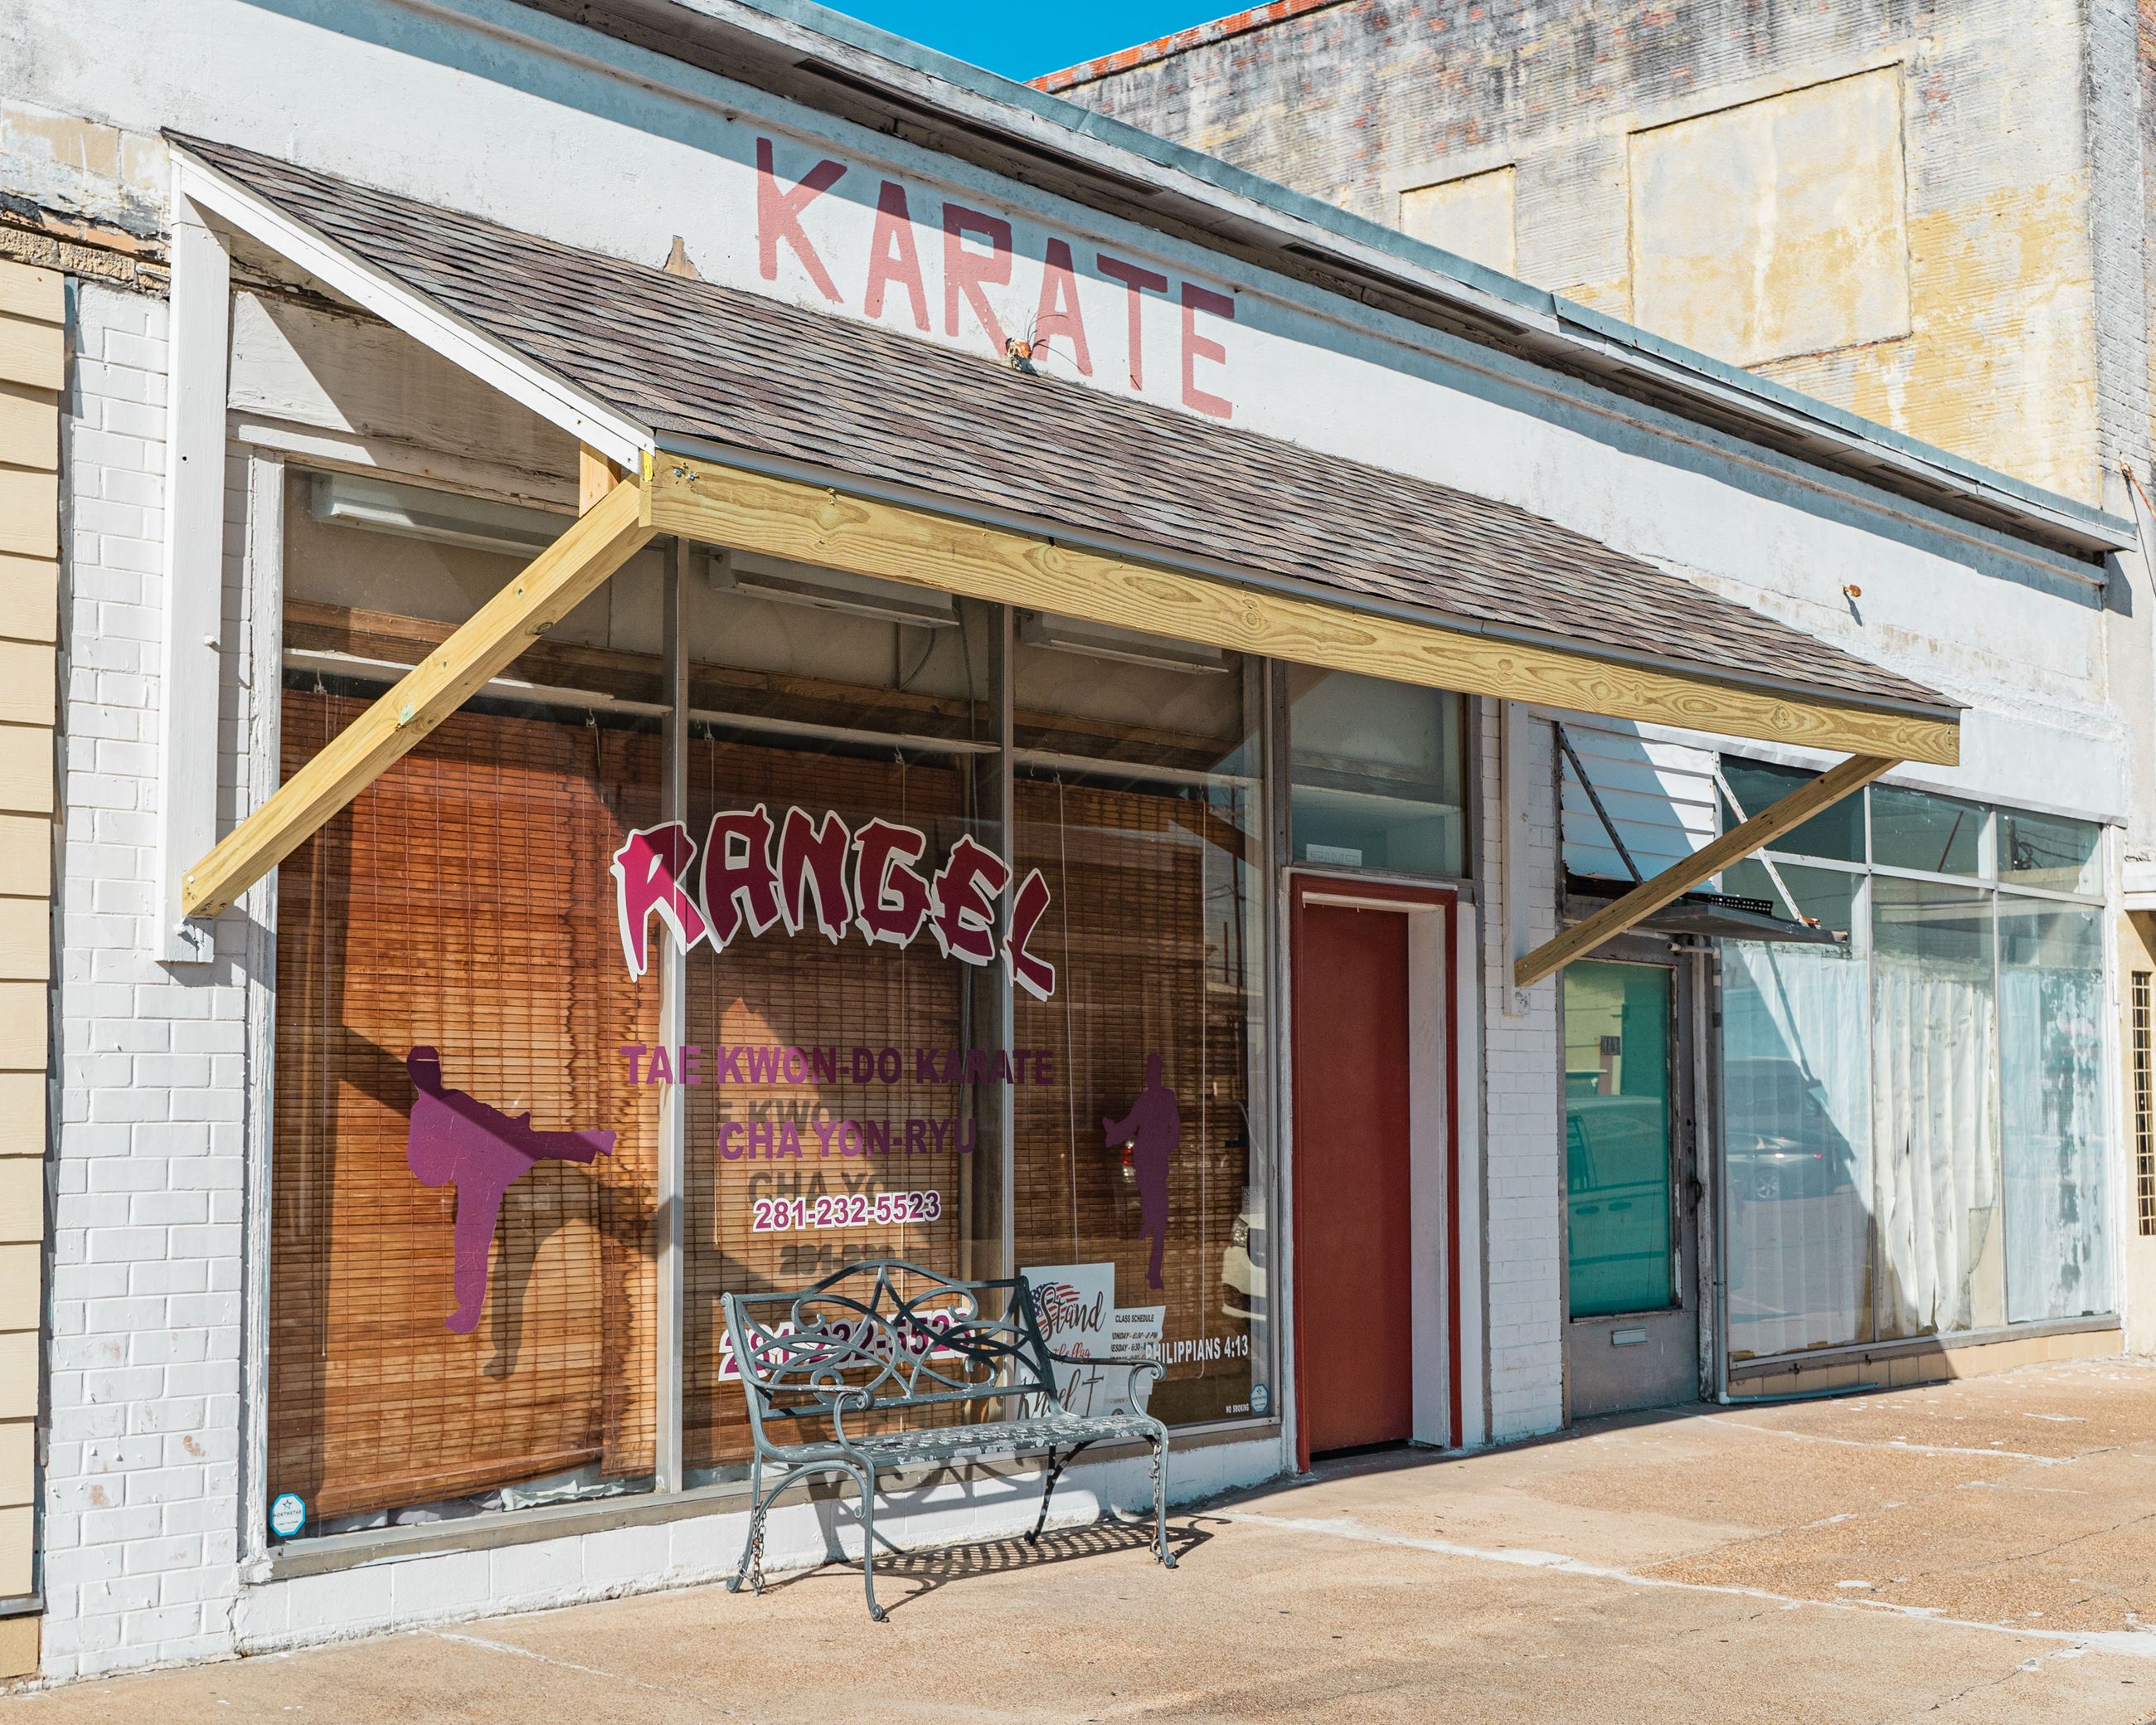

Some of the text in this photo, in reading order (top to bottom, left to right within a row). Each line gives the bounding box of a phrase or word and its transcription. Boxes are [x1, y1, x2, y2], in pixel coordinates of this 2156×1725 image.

[756, 137, 1235, 419] KARATE
[610, 803, 1055, 1001] RANGEL
[620, 1045, 1054, 1086] TAE KWON-DO KARATE
[719, 1117, 977, 1160] CHA YON-RYU
[753, 1189, 941, 1232] 281-232-5523
[1041, 1286, 1107, 1343] Stand
[1115, 1314, 1154, 1323] CLASS SCHEDULE
[1144, 1334, 1248, 1364] PHILIPPIANS 4:13
